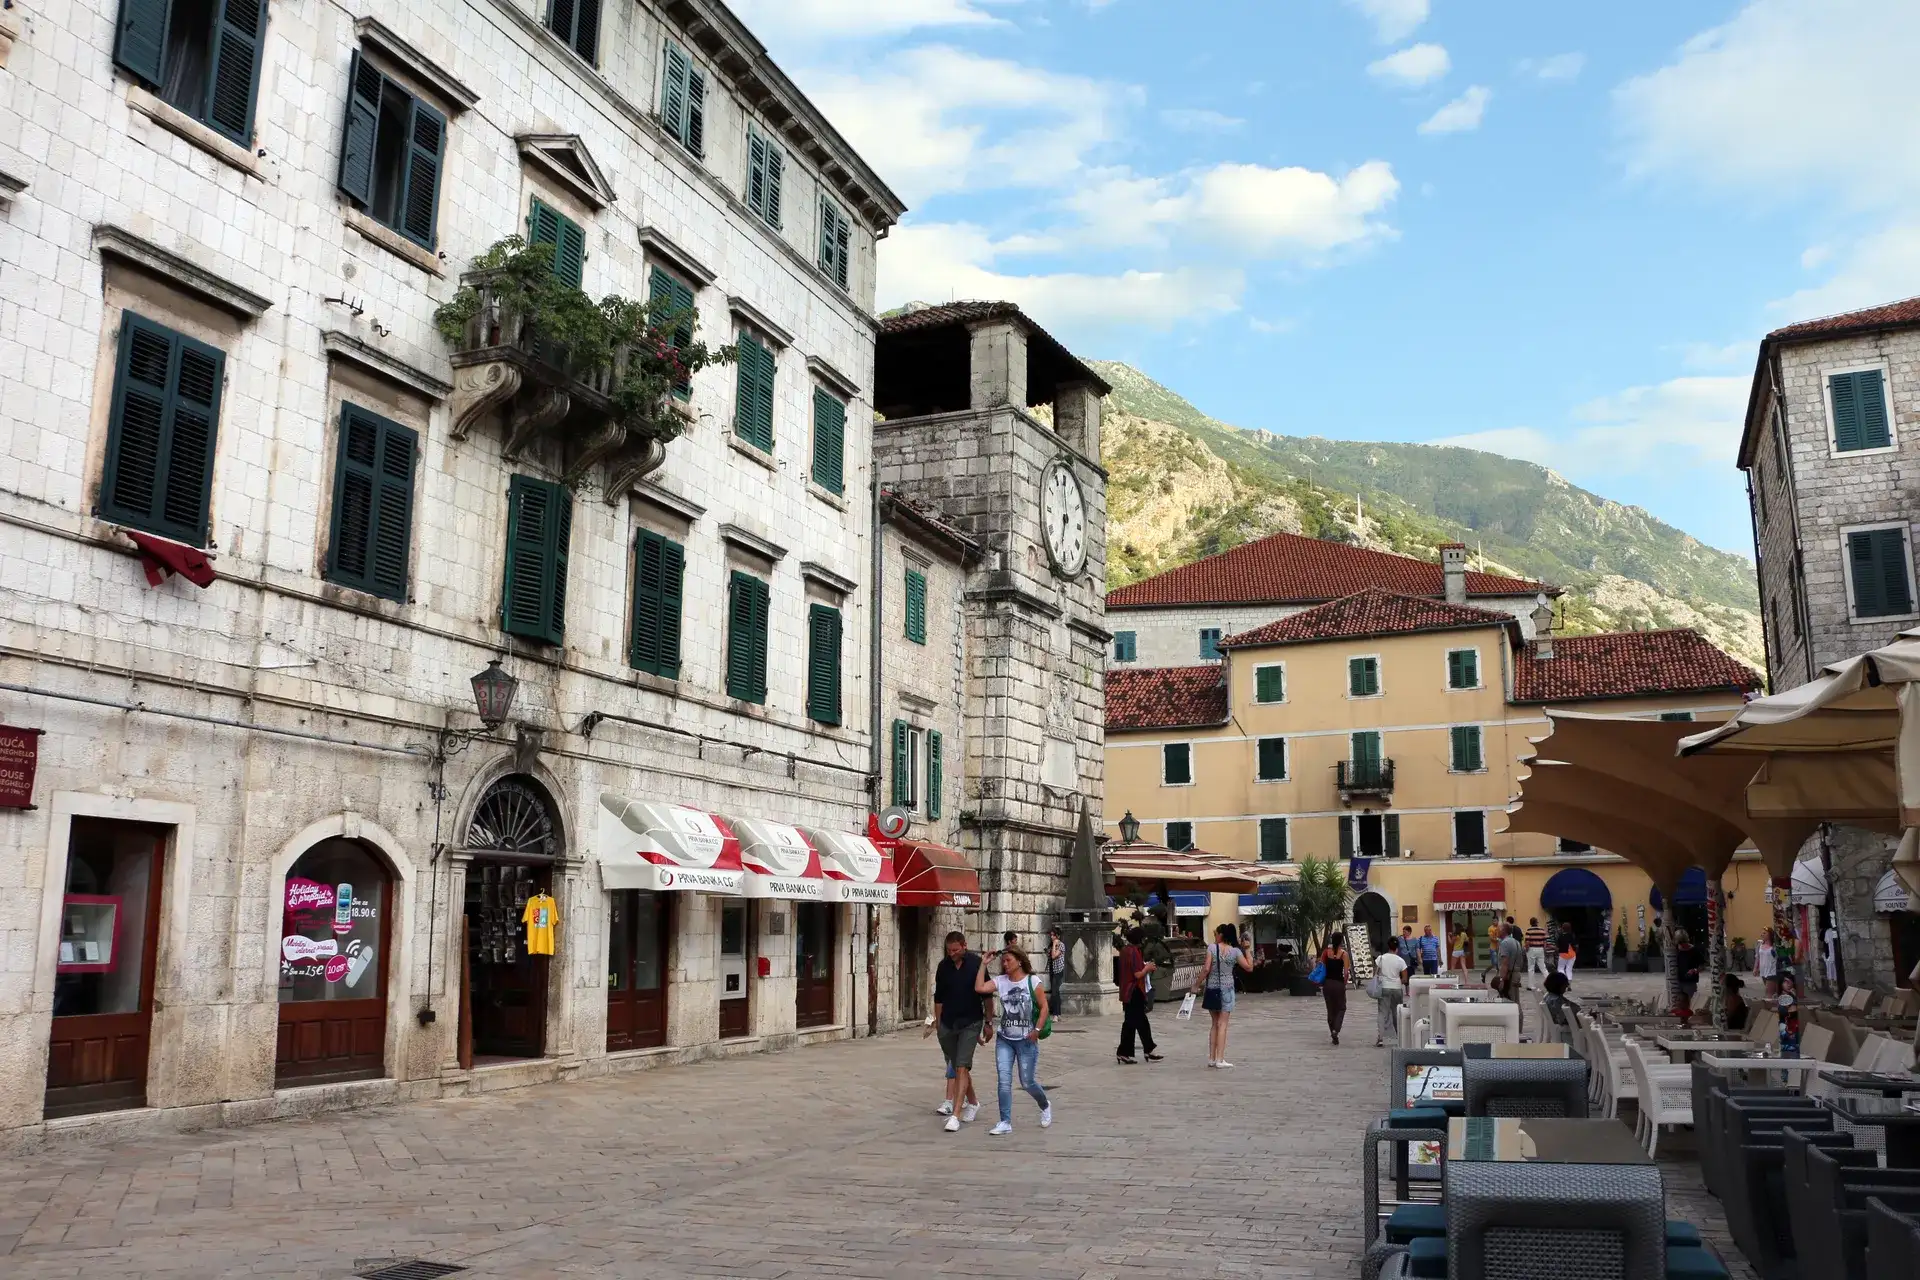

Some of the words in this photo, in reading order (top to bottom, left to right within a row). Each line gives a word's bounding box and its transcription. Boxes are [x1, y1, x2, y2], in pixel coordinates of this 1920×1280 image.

[677, 873, 698, 884] PRVA
[697, 874, 723, 886] BANKA
[722, 876, 734, 887] CG
[289, 883, 320, 896] Holiday
[769, 882, 786, 893] PRVA
[785, 883, 807, 894] BANKA
[806, 884, 817, 895] CG
[851, 887, 864, 897] PRVA
[864, 888, 881, 898] BANKA
[880, 889, 889, 899] CG
[1443, 902, 1466, 910] OPTIKA
[351, 908, 370, 918] 18.90
[370, 908, 377, 918] €
